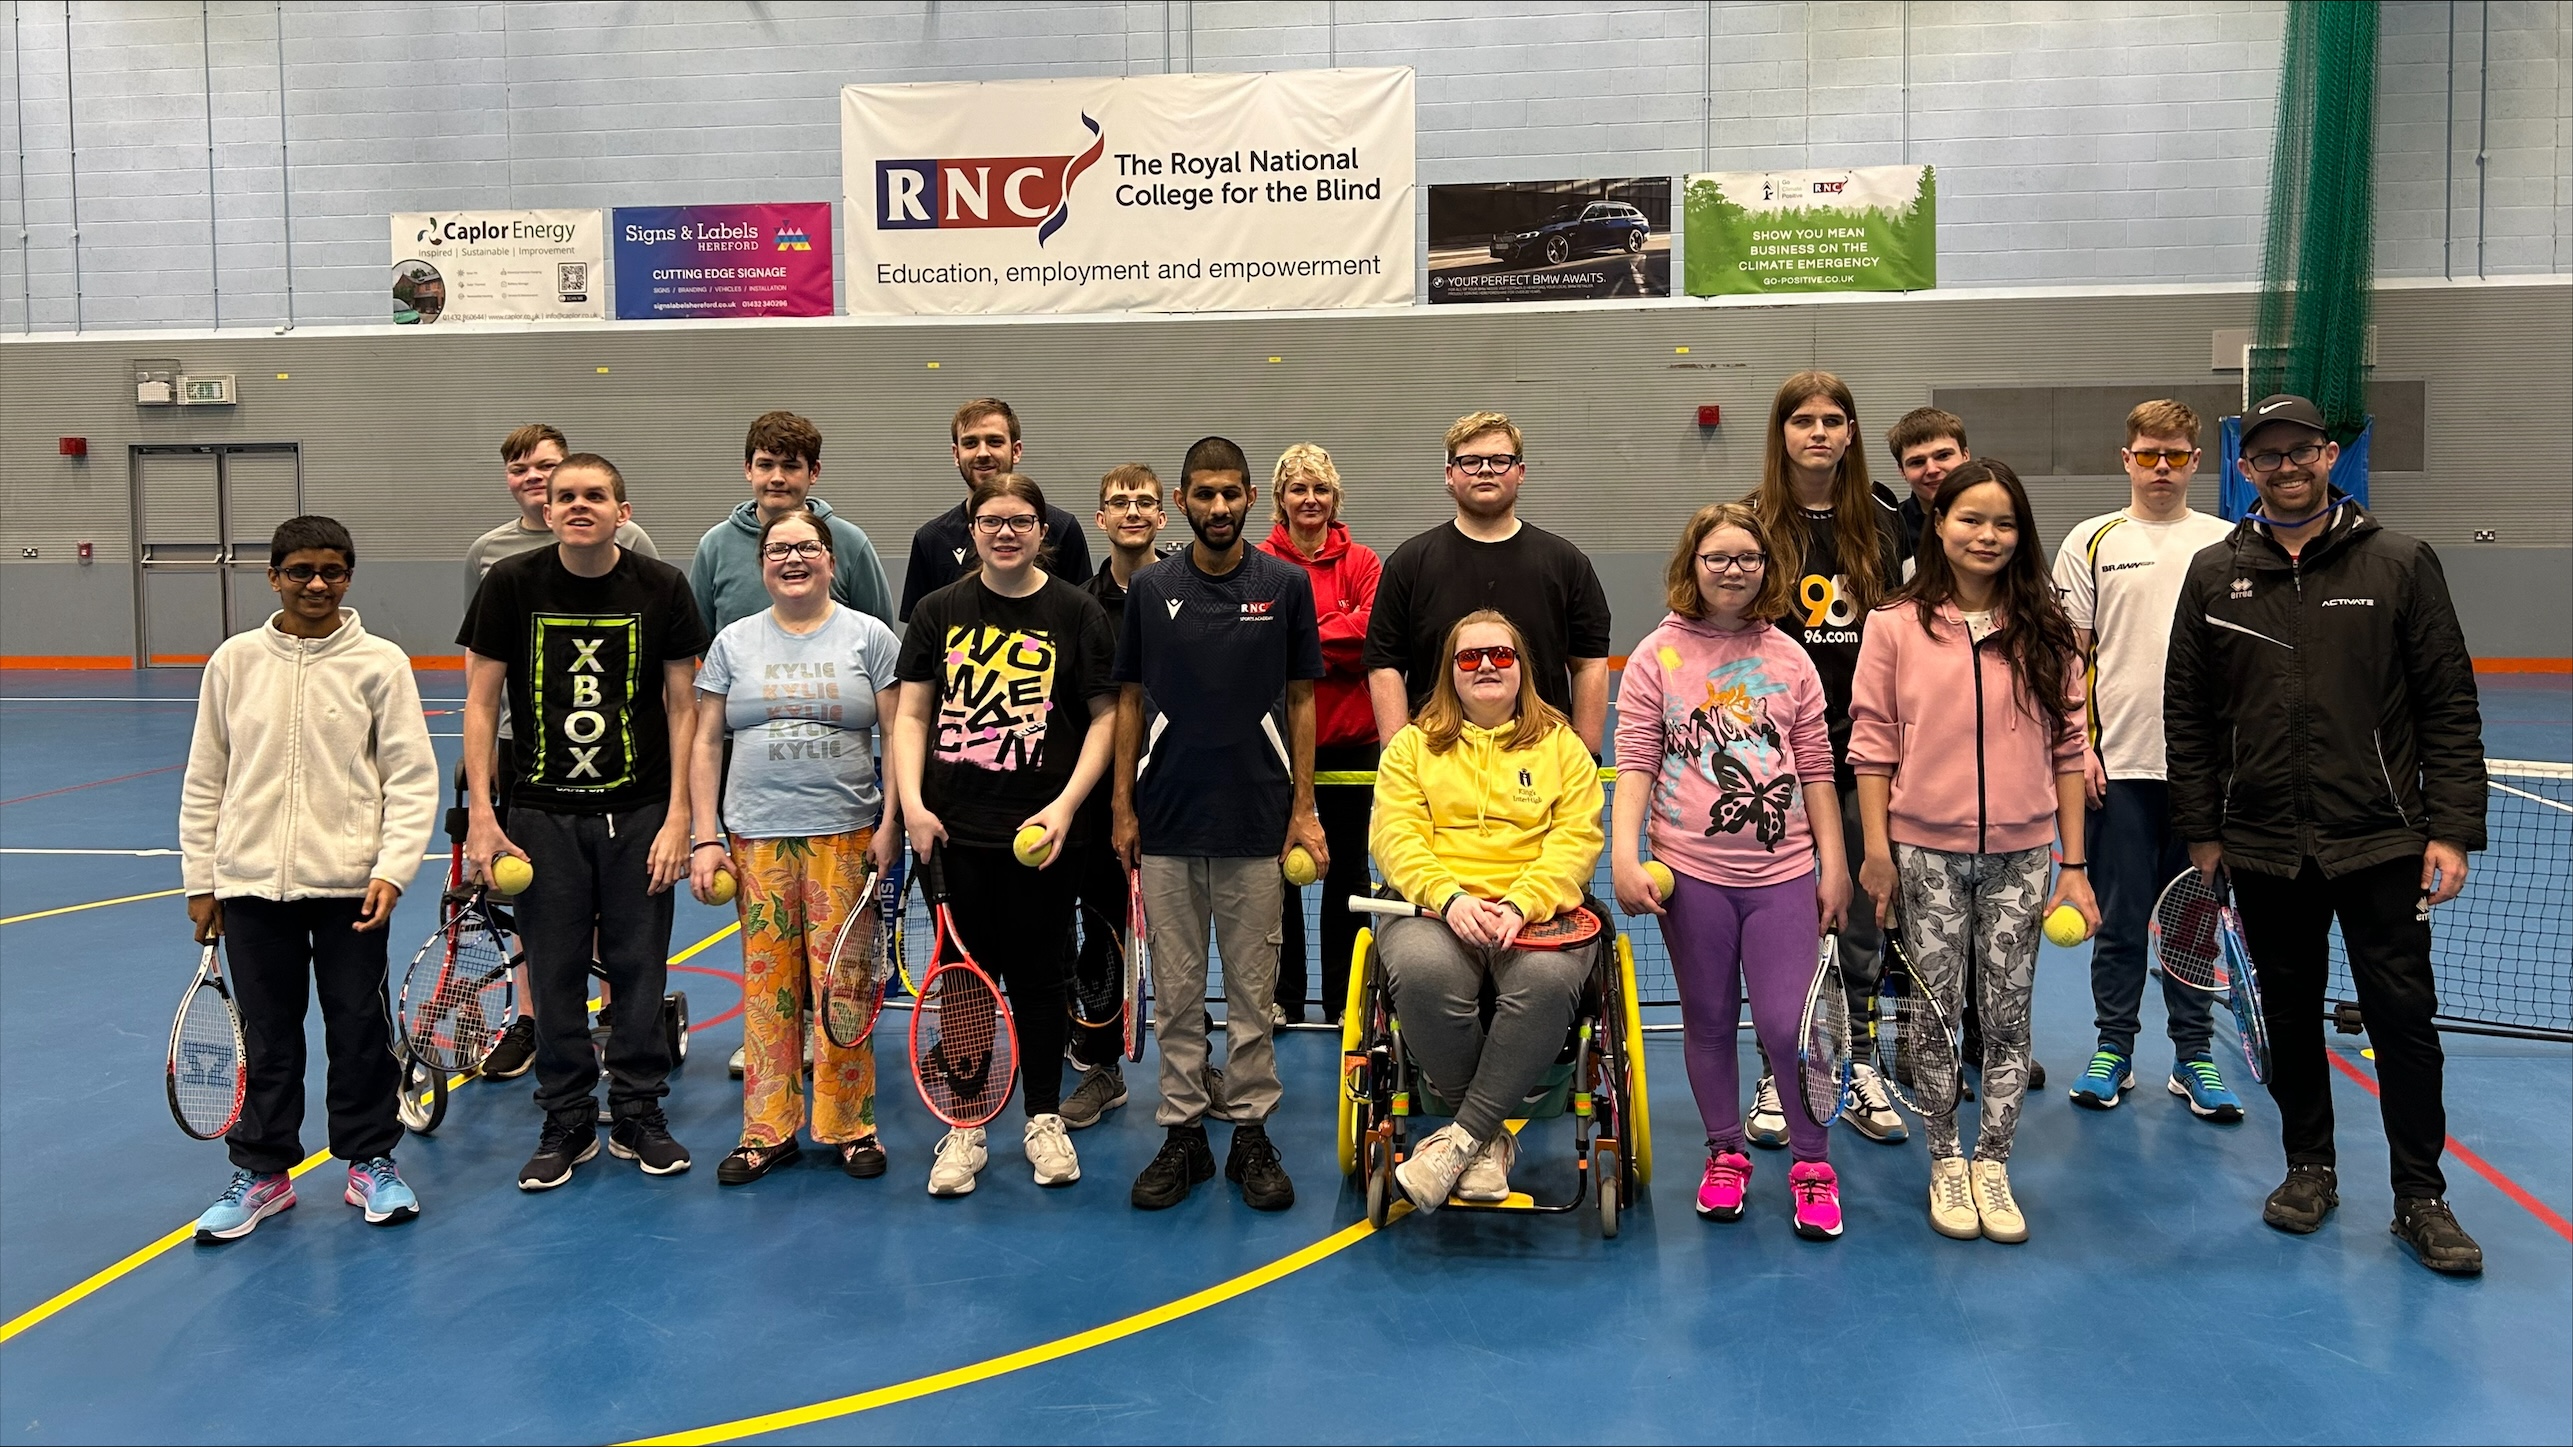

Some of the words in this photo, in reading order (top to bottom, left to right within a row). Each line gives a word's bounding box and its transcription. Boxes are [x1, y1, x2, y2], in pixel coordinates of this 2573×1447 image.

[1114, 153, 1162, 176] The
[1170, 151, 1242, 180] Royal
[1248, 147, 1359, 173] National
[884, 167, 1052, 222] RNC
[1114, 182, 1214, 210] College
[1220, 180, 1258, 204] for
[1264, 179, 1309, 203] the
[1315, 177, 1381, 201] Blind
[1814, 183, 1842, 192] RNC
[443, 220, 509, 244] Caplor
[513, 220, 576, 242] Energy
[625, 224, 676, 245] Signs
[680, 226, 693, 240] &
[697, 221, 759, 239] Labels
[1752, 230, 1793, 241] SHOW
[1796, 229, 1824, 240] YOU
[1827, 227, 1865, 239] MEAN
[418, 248, 453, 258] Inspired
[461, 246, 510, 257] Sustainable
[518, 246, 575, 258] Improvement
[698, 241, 759, 252] HEREFORD
[1750, 244, 1815, 256] BUSINESS
[1818, 243, 1839, 255] ON
[1842, 242, 1868, 253] THE
[877, 262, 999, 287] Education,
[1005, 259, 1150, 287] employment
[1158, 258, 1201, 280] and
[1208, 255, 1381, 284] empowerment
[1738, 260, 1794, 271] CLIMATE
[1797, 257, 1880, 269] EMERGENCY
[653, 269, 702, 280] CUTTING
[704, 268, 735, 279] EDGE
[737, 267, 787, 278] SIGNAGE
[1448, 276, 1479, 287] YOUR
[1481, 274, 1531, 287] PERFECT
[1532, 273, 1560, 285] BMW
[1561, 272, 1607, 284] AWAITS.
[1763, 274, 1855, 286] GO-POSITIVE.CO.UK
[714, 285, 742, 293] VEHICLES
[442, 312, 461, 321] 01432
[1801, 574, 1858, 627] 96
[2322, 598, 2374, 608] ACTIVATE
[1240, 603, 1267, 613] RNC
[1804, 630, 1858, 644] 96.com
[764, 662, 836, 679] KYLIE
[762, 682, 840, 701] KYLIE
[563, 638, 607, 779] XBOX
[768, 740, 841, 761] KYLIE
